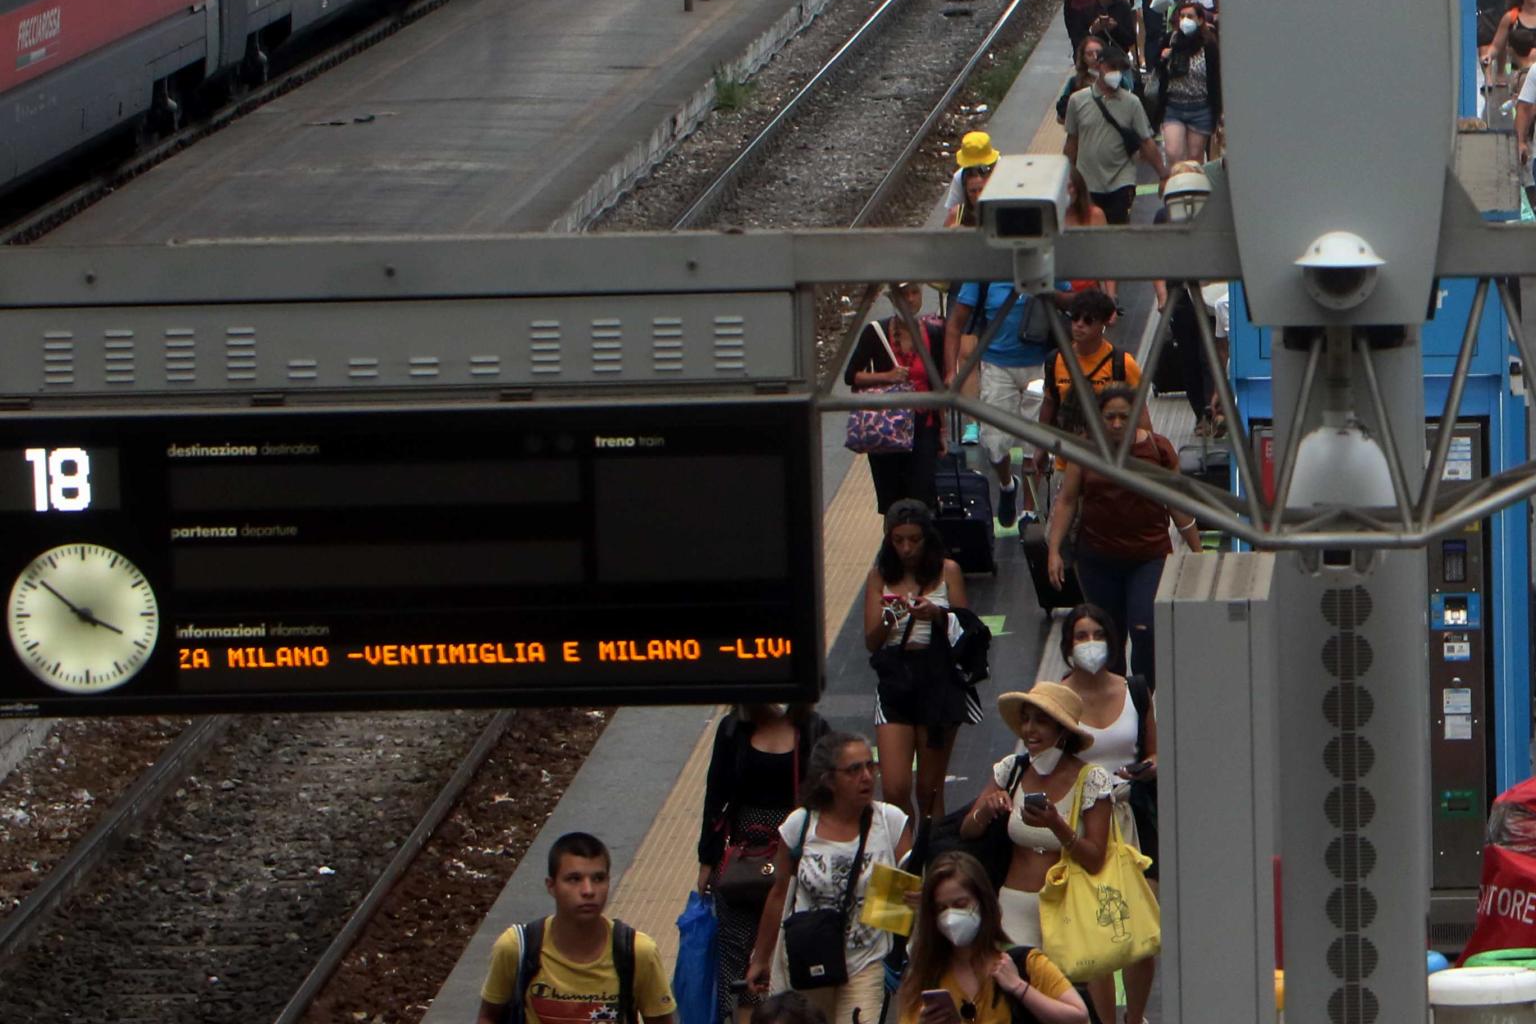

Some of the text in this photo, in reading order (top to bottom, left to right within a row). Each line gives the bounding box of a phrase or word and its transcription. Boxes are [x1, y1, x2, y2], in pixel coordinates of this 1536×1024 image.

[17, 7, 61, 51] FRECCIAROSSA
[167, 442, 319, 457] destinazione destination
[595, 435, 636, 447] treno
[25, 447, 91, 511] 18
[171, 524, 297, 540] partenza departure
[176, 624, 329, 638] informazioni information
[228, 646, 329, 668] MILANO
[347, 642, 546, 666] -VENTIMIGLIA
[562, 641, 581, 662] E
[598, 639, 701, 661] MILANO
[719, 637, 791, 658] -LIV
[531, 983, 620, 1002] Champio
